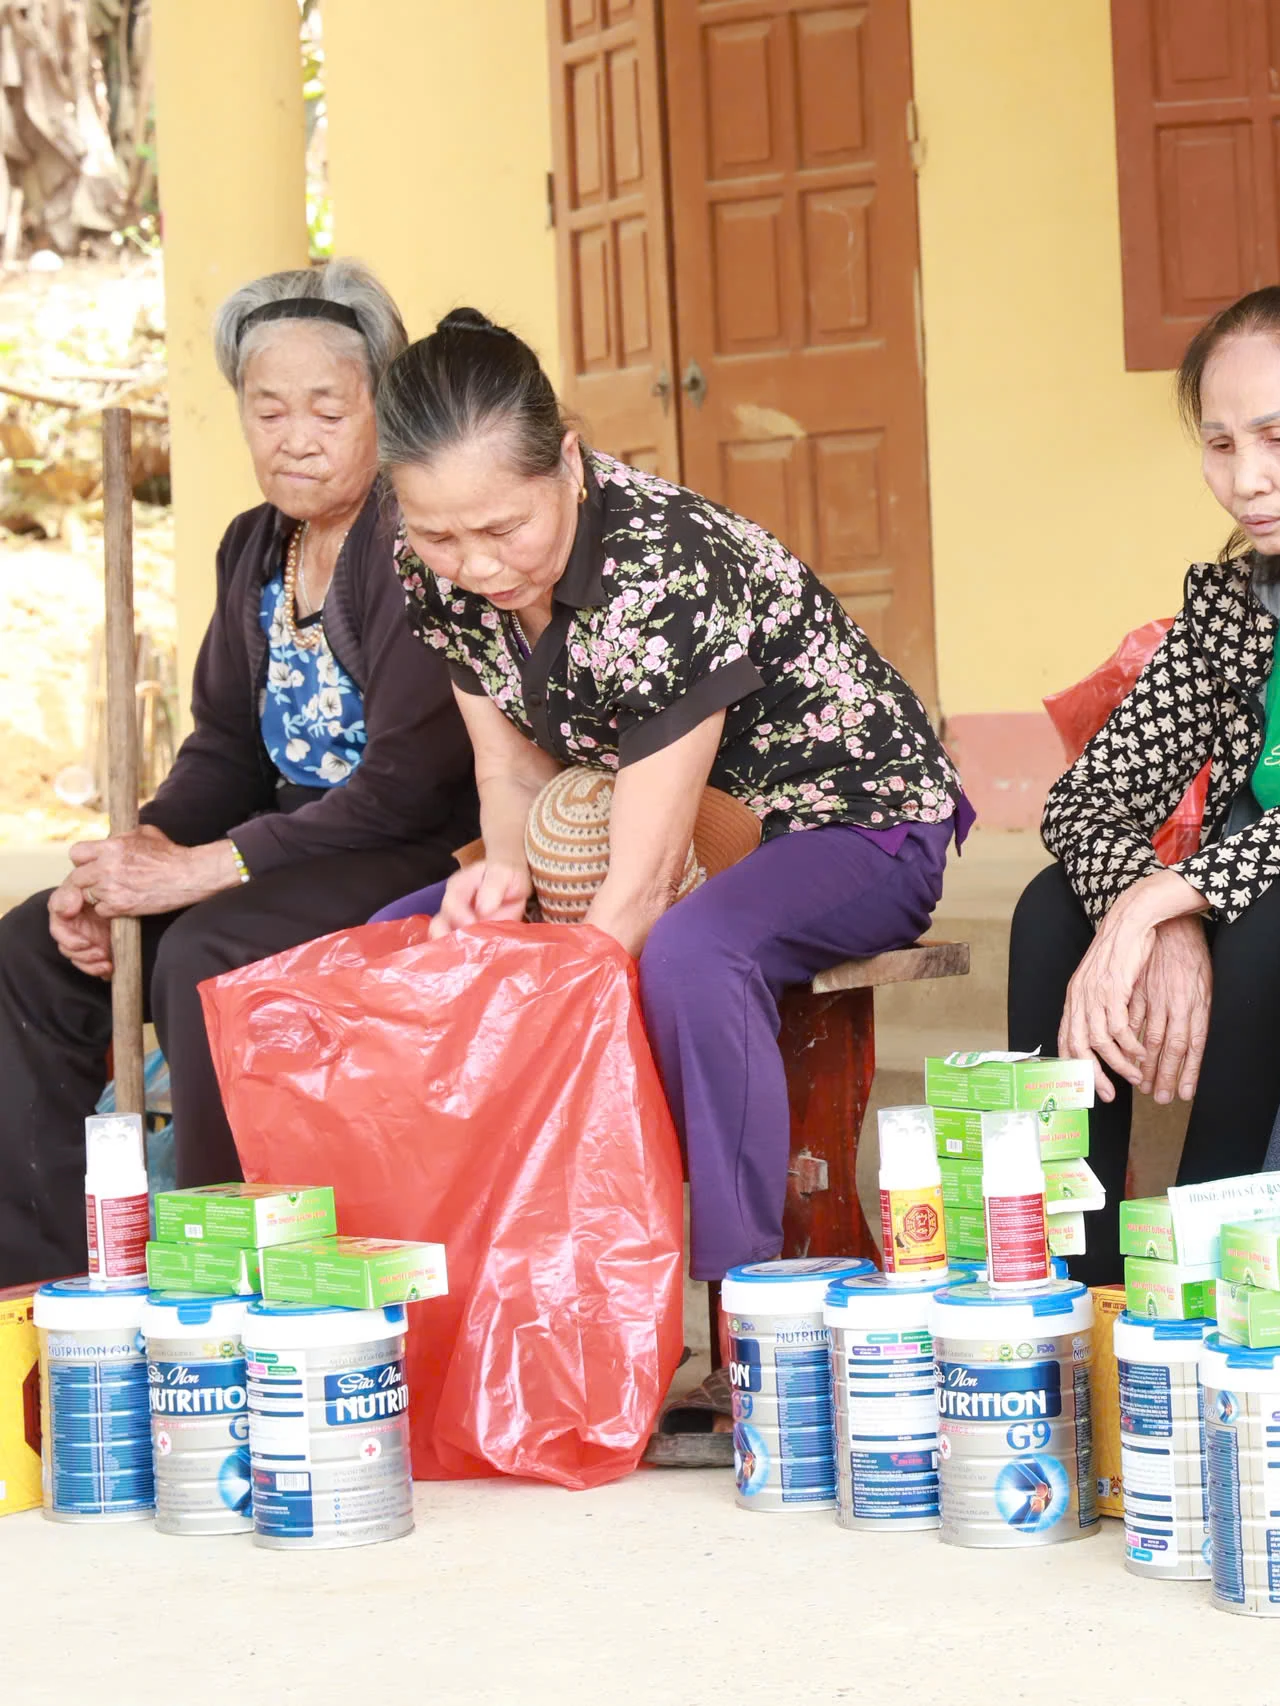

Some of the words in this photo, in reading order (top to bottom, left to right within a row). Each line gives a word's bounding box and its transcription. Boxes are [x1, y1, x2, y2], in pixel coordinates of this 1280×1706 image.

[337, 1373, 375, 1394] Sữa
[149, 1386, 247, 1413] NUTRITIO
[229, 1415, 250, 1440] G
[1006, 1421, 1051, 1450] G9
